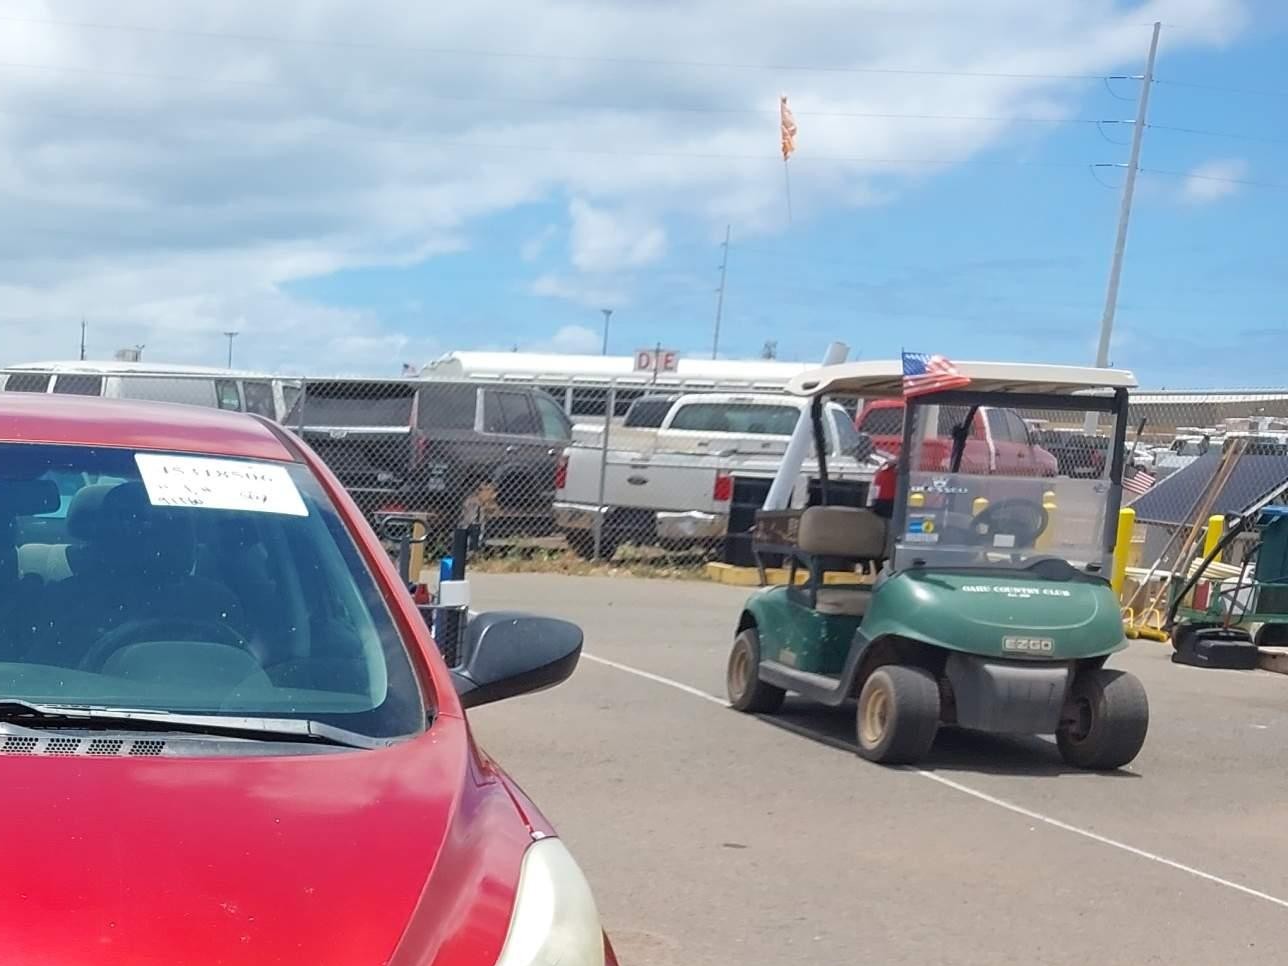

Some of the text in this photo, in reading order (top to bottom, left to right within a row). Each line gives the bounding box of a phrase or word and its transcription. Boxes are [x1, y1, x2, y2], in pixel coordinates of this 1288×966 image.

[993, 586, 1040, 595] COUNTRY
[1042, 588, 1072, 597] CLUB
[1005, 639, 1052, 650] EZGO
